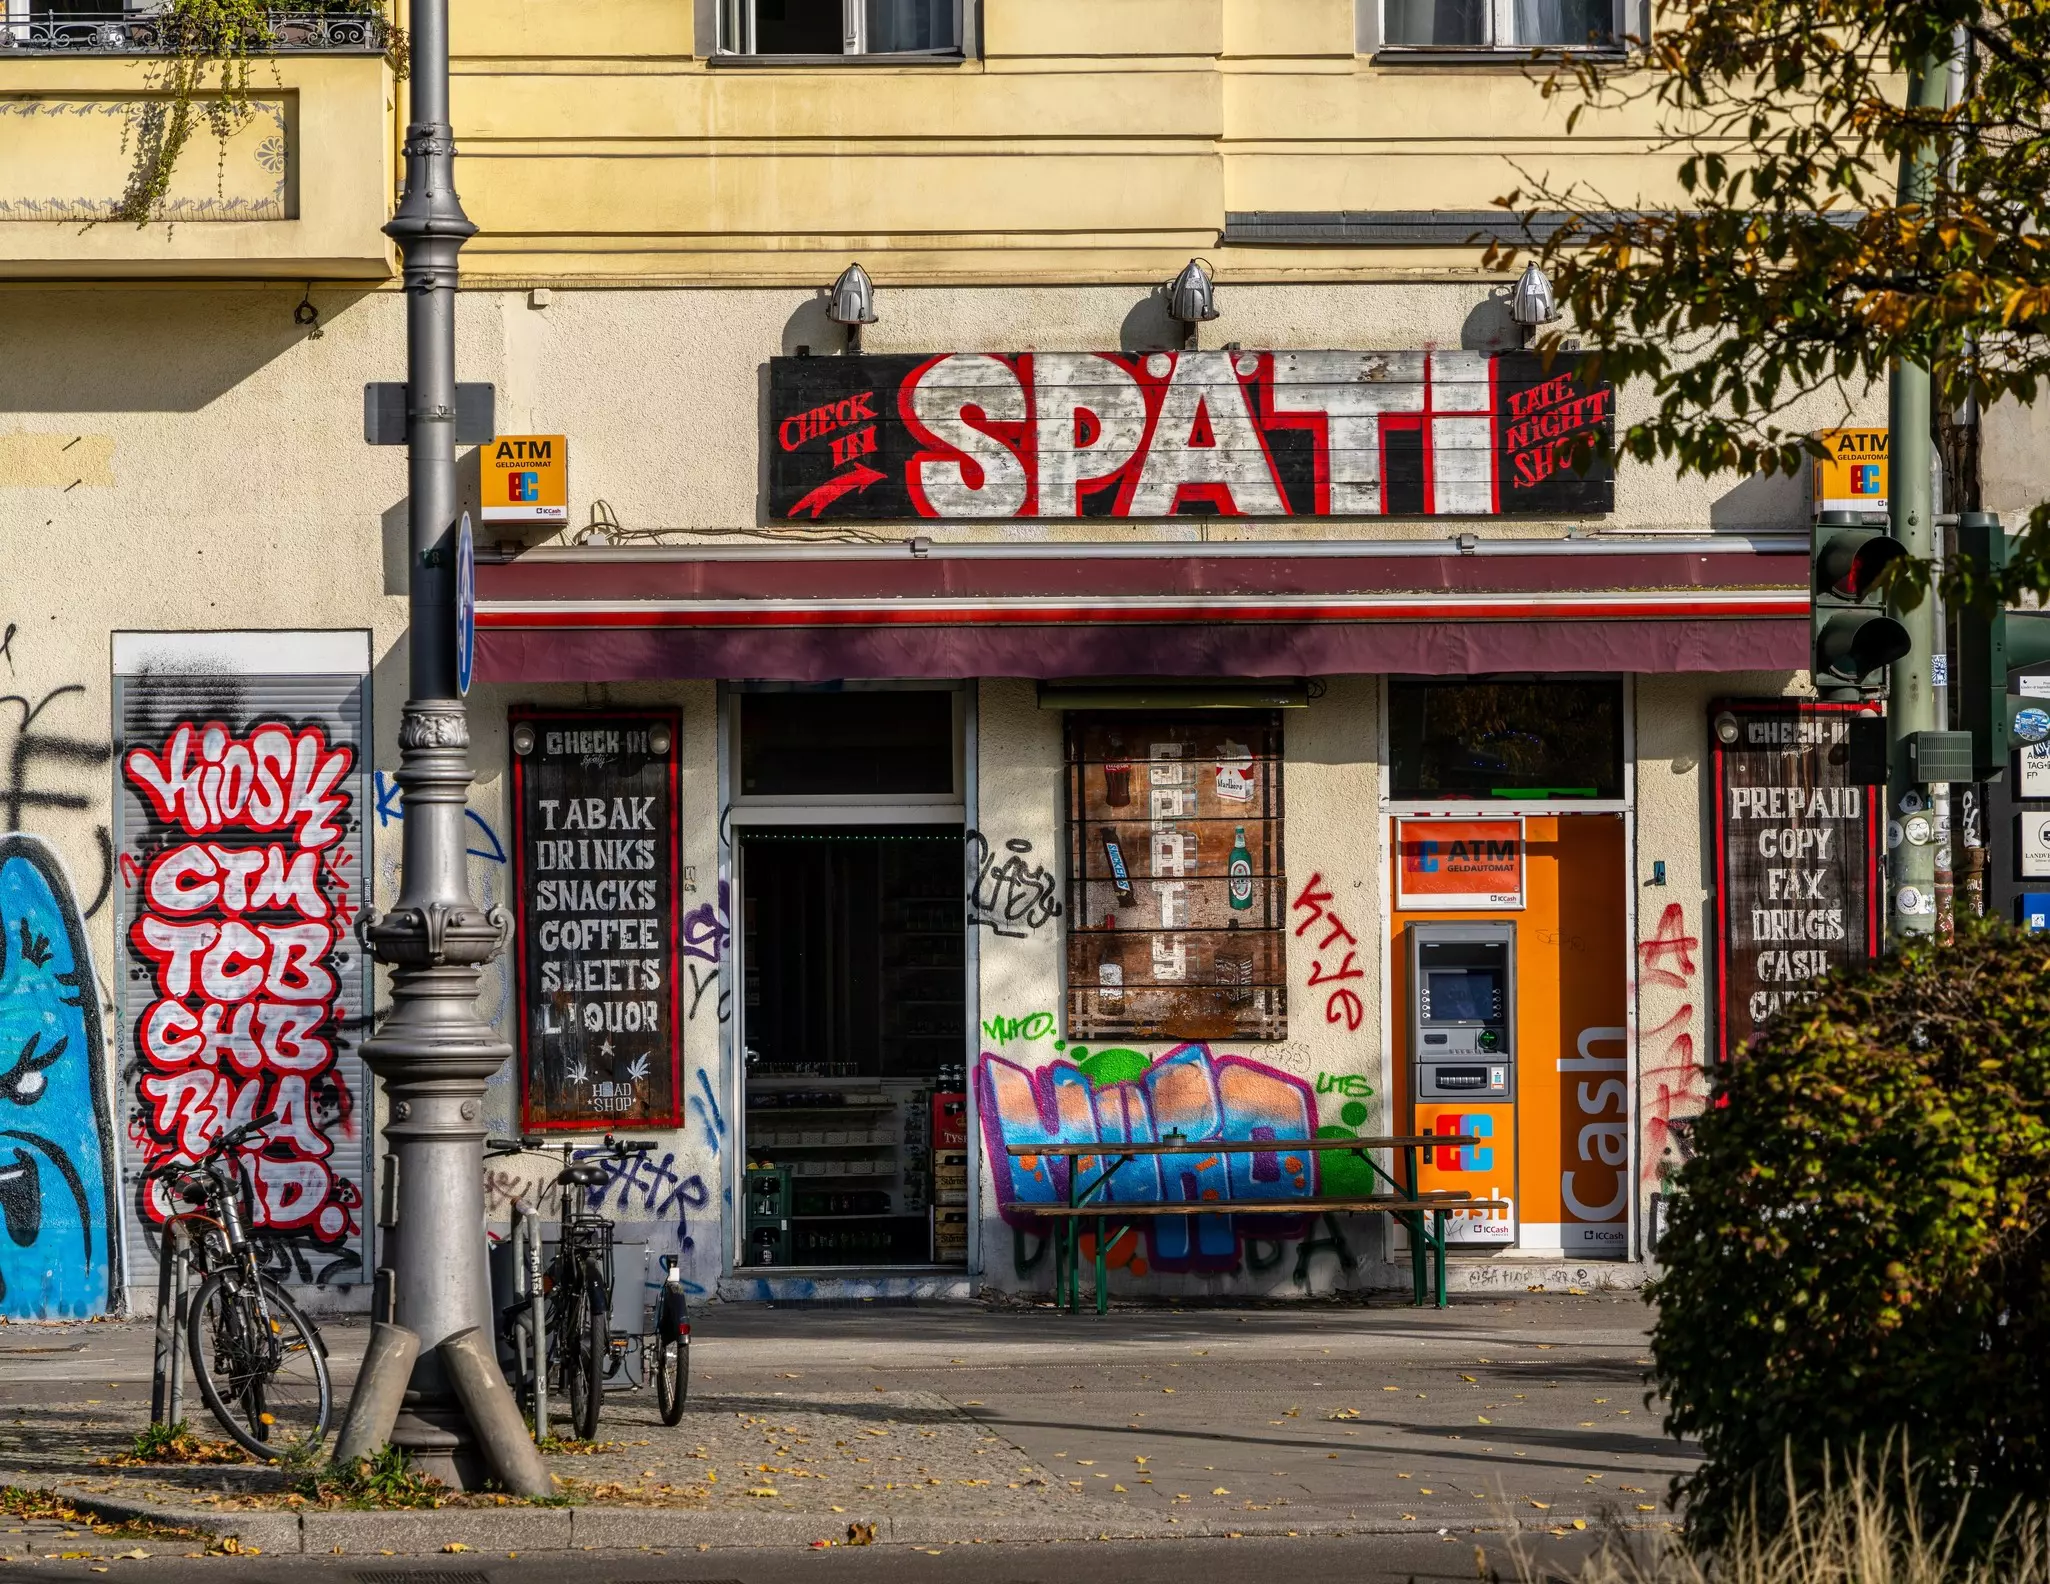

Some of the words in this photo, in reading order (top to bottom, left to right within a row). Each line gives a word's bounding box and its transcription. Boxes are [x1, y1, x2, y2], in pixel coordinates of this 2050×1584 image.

[1507, 372, 1575, 422] LATE
[778, 391, 878, 452] CHECK
[496, 441, 551, 459] ATM
[827, 425, 878, 469] IN
[1838, 434, 1889, 452] ATM
[546, 731, 648, 755] CHECK-IN
[1217, 778, 1243, 791] Marlboro
[538, 796, 656, 831] TABAK
[1730, 787, 1861, 820] PREPAID
[536, 839, 656, 870] DRINKS
[1447, 840, 1515, 861] ATM
[1759, 828, 1833, 859] COPY
[1447, 864, 1514, 872] GELDAUTOMAT
[536, 880, 656, 911] SNACKS
[1768, 869, 1826, 900] FAX
[539, 918, 659, 951] COFFEE
[1752, 909, 1845, 941] DRUGS
[592, 1082, 632, 1097] HAD
[593, 1097, 632, 1112] SHOP
[1556, 1026, 1628, 1221] Cash
[1483, 1225, 1509, 1233] ICCash
[1595, 1231, 1624, 1240] ICCash
